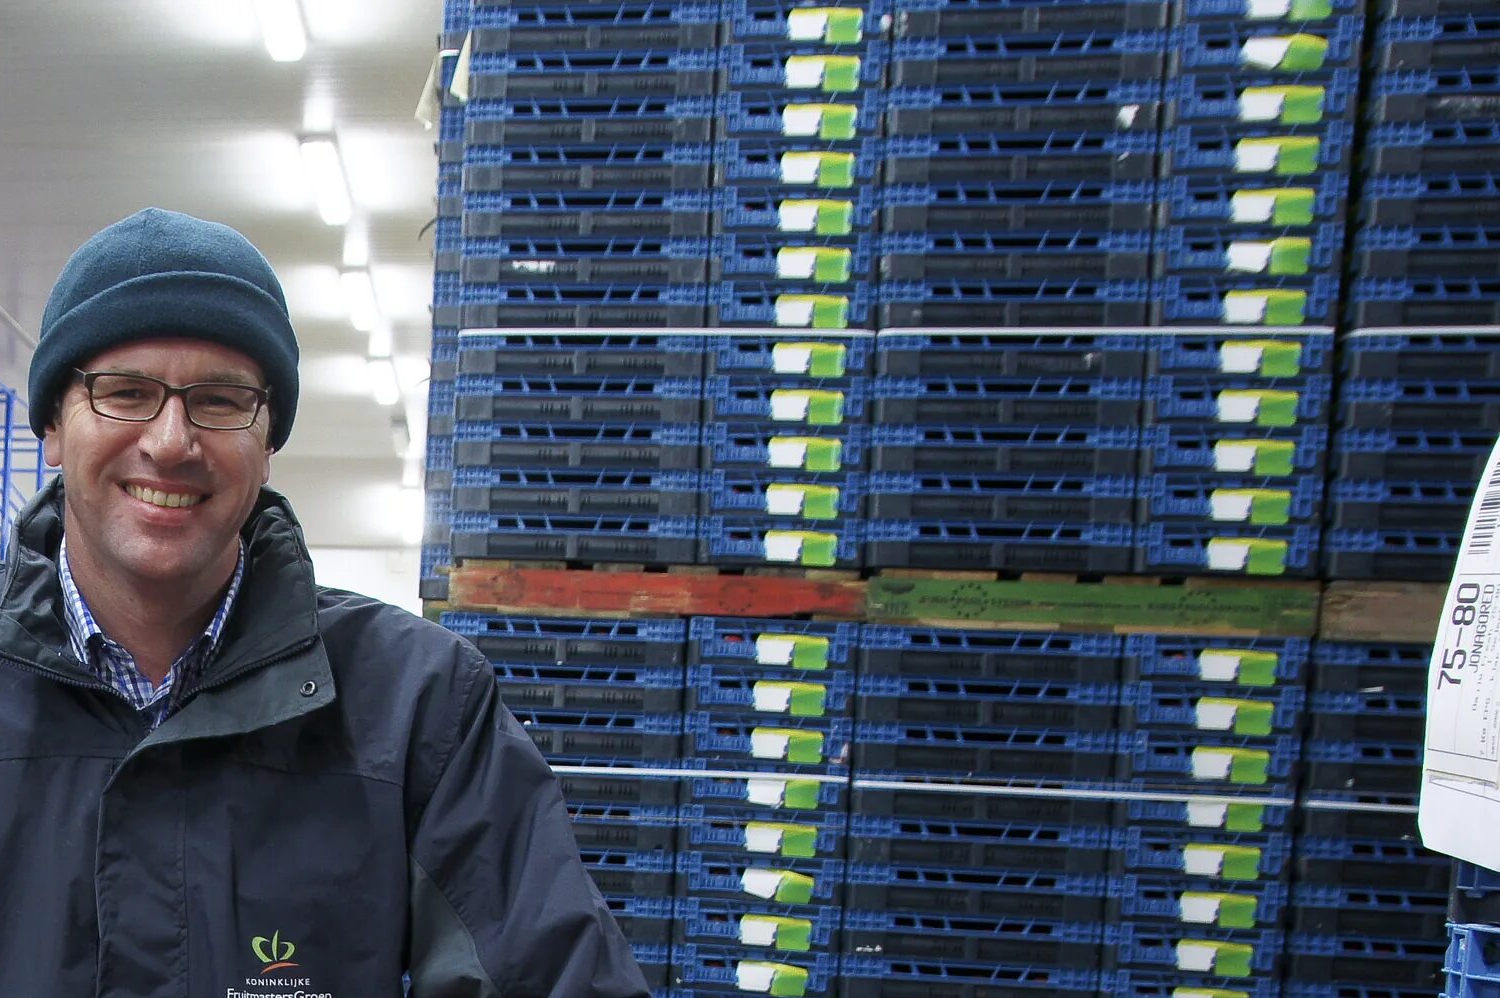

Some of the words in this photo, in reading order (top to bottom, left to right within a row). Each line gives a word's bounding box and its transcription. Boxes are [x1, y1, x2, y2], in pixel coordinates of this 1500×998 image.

[1437, 582, 1480, 690] 75-80
[1468, 584, 1495, 674] JONAGORED
[246, 978, 310, 987] KONINKLIJKE
